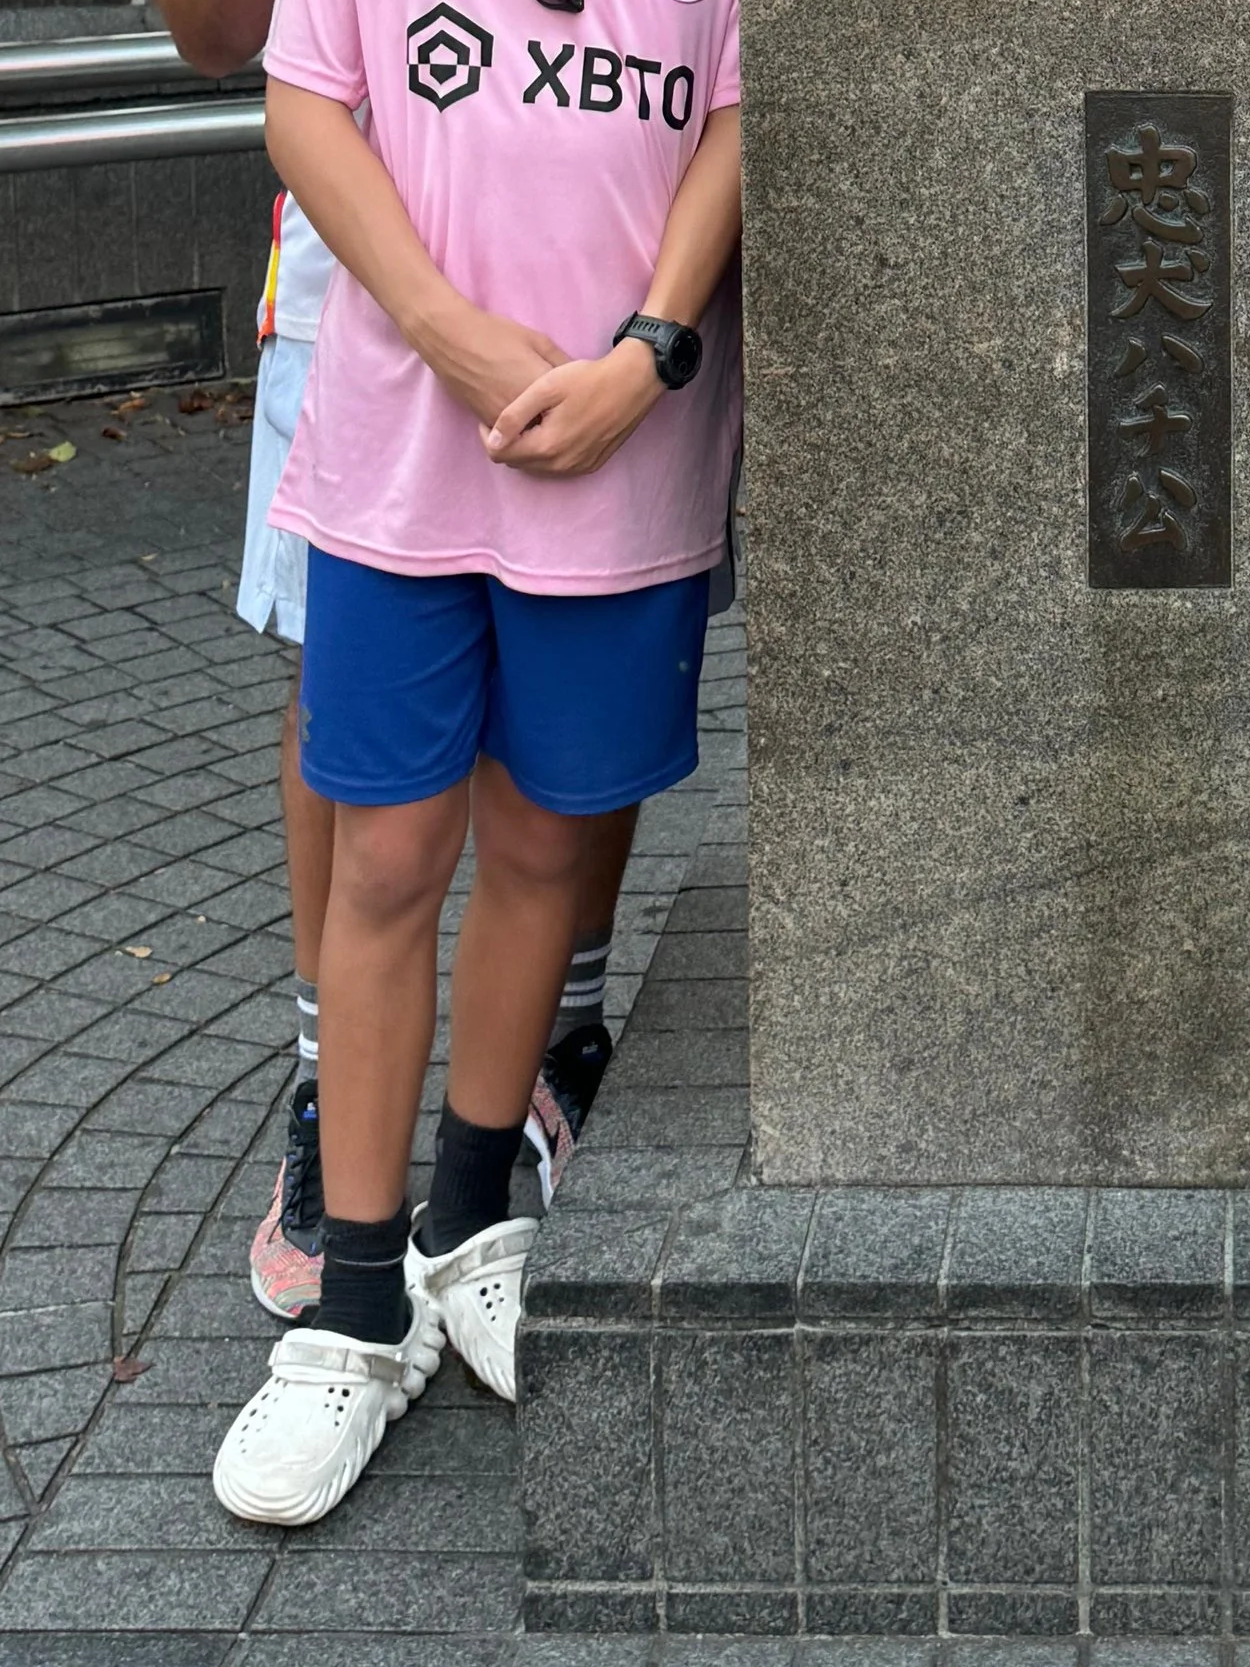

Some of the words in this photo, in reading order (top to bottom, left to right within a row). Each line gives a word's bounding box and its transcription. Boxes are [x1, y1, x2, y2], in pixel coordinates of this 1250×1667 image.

[522, 39, 695, 131] XBTO
[1100, 124, 1213, 553] 忠犬ハチ公
